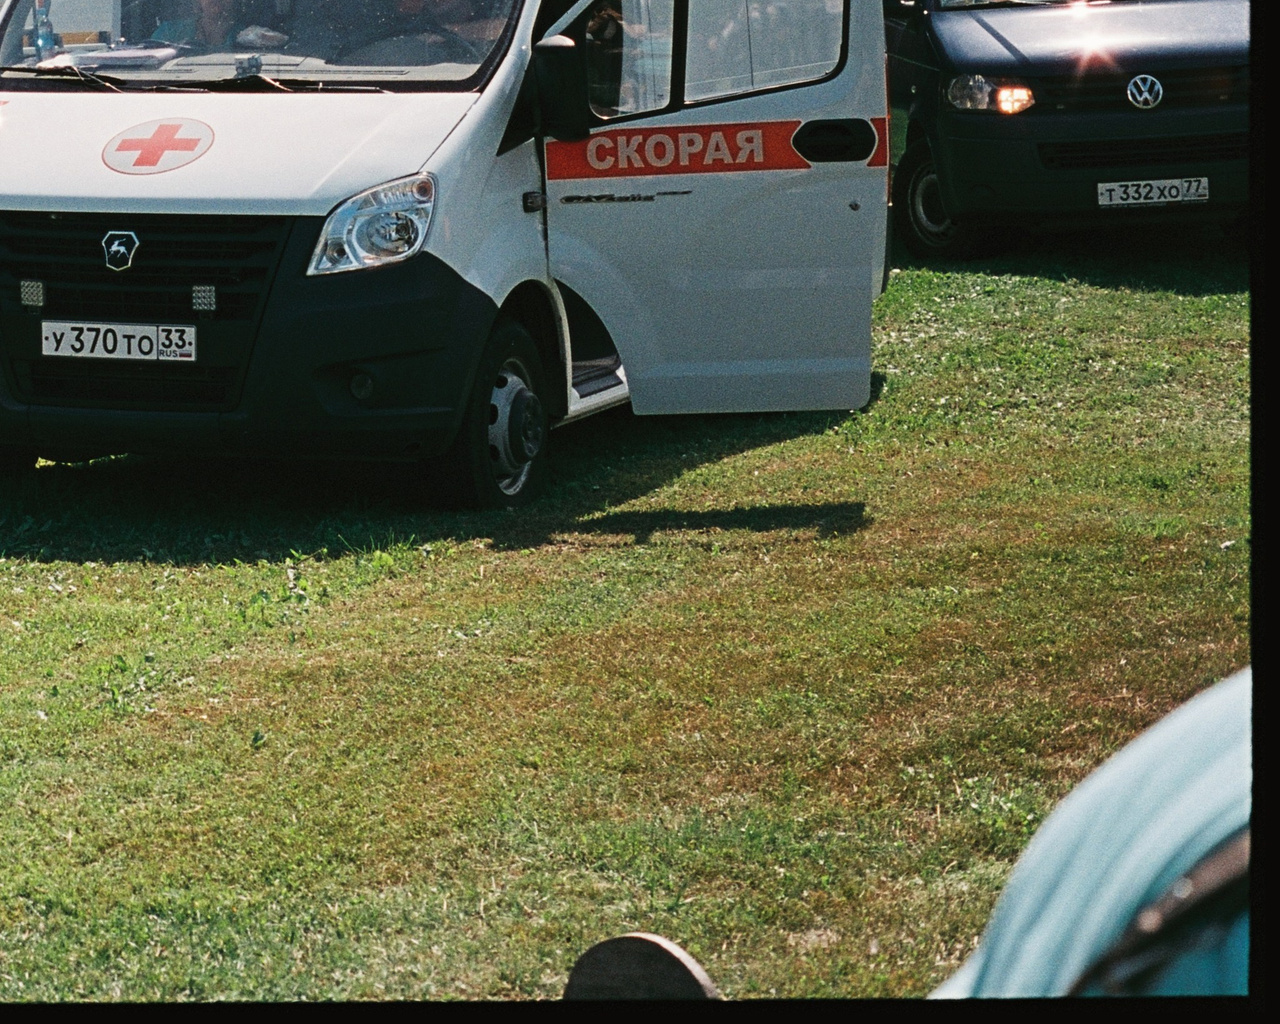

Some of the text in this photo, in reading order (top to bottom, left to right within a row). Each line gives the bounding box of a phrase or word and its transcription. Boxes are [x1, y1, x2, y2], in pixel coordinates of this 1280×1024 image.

[586, 129, 764, 171] СКОРАЯ
[1183, 179, 1202, 193] 77
[160, 328, 187, 349] 33
[158, 349, 179, 358] RUS
